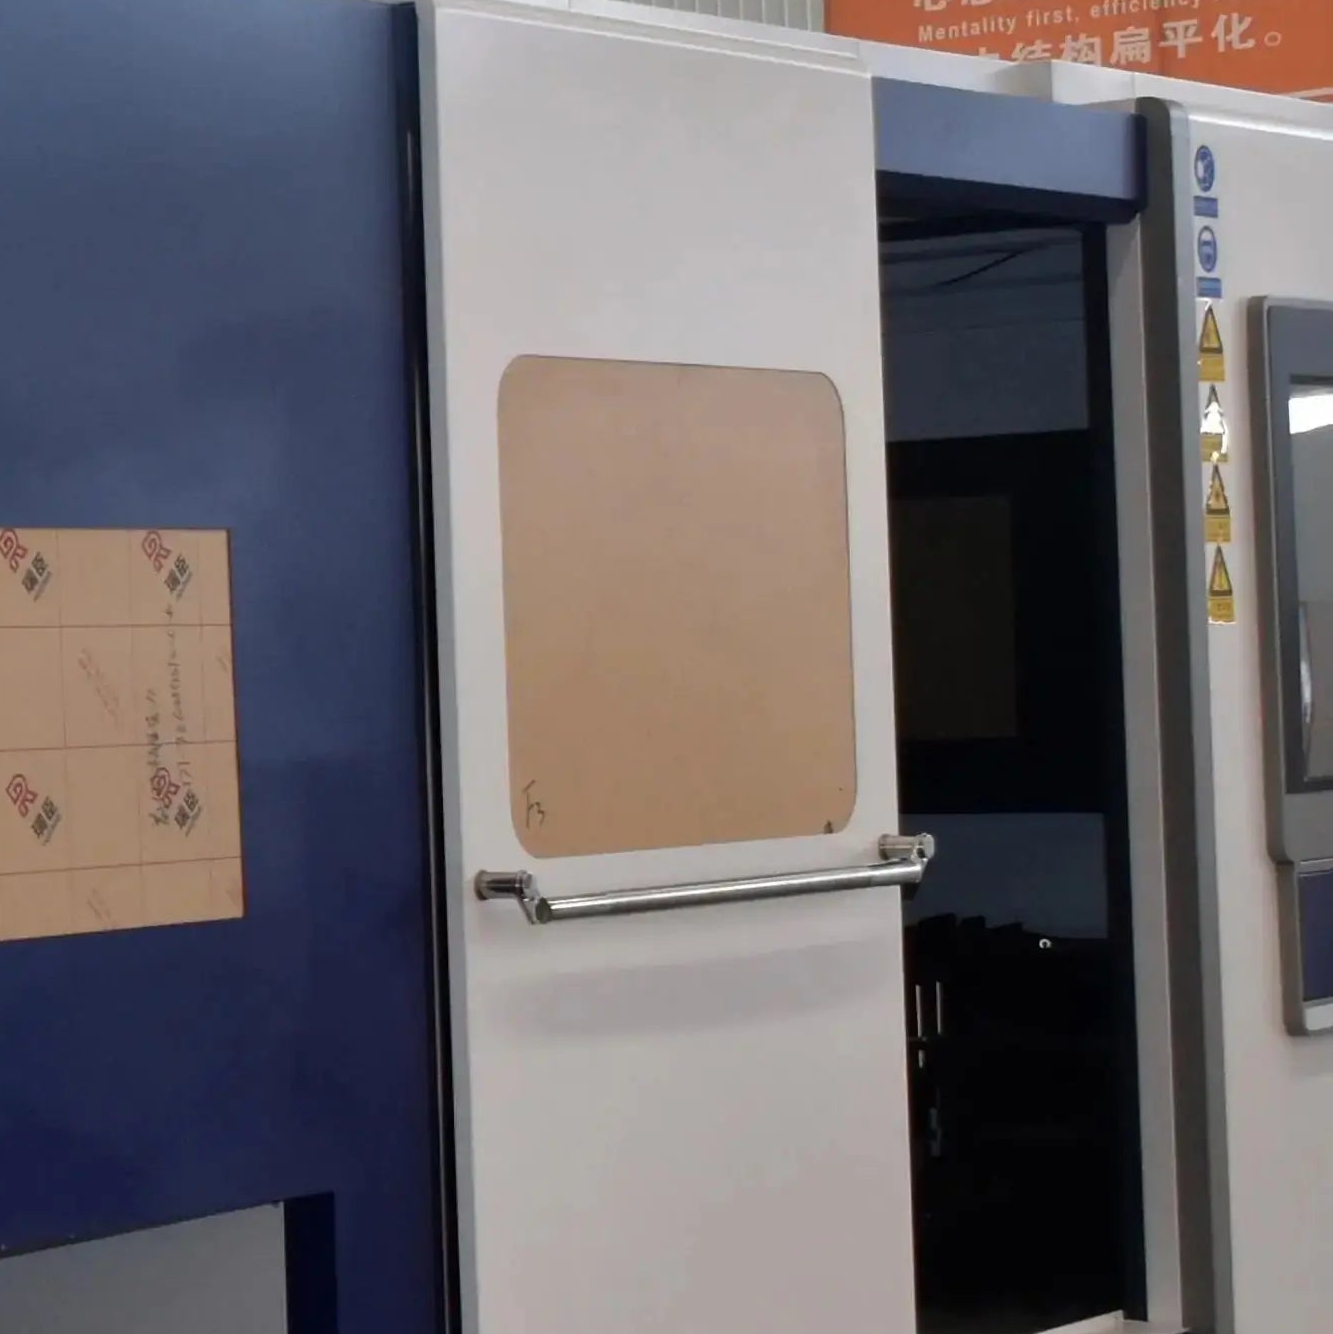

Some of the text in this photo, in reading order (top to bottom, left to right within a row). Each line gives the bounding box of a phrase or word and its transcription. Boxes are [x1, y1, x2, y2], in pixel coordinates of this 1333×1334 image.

[918, 16, 1016, 42] Mentality
[1027, 5, 1080, 27] first,
[978, 13, 1282, 66] 结构扁平化。
